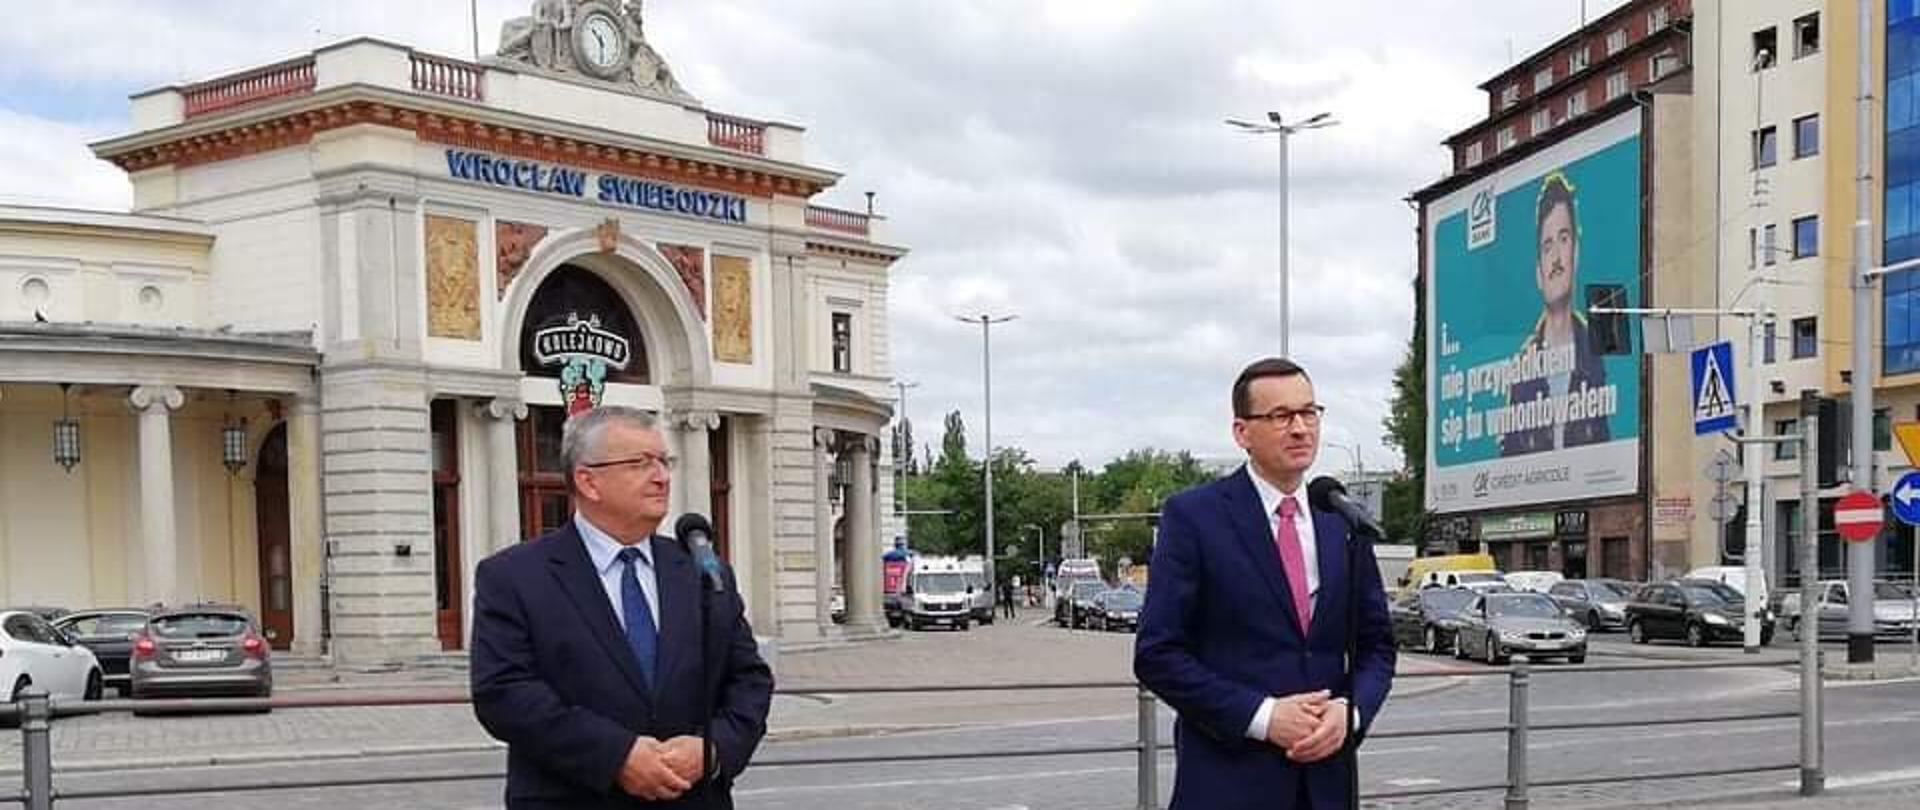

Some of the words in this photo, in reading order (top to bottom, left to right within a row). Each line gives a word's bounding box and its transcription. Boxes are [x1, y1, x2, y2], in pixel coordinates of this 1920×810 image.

[543, 327, 623, 360] KOLEJKOWO
[1441, 365, 1464, 401] nie
[1467, 341, 1576, 402] przypadkiem
[1441, 408, 1464, 452] się
[1466, 407, 1483, 439] tu
[1486, 381, 1617, 437] wmontowałem
